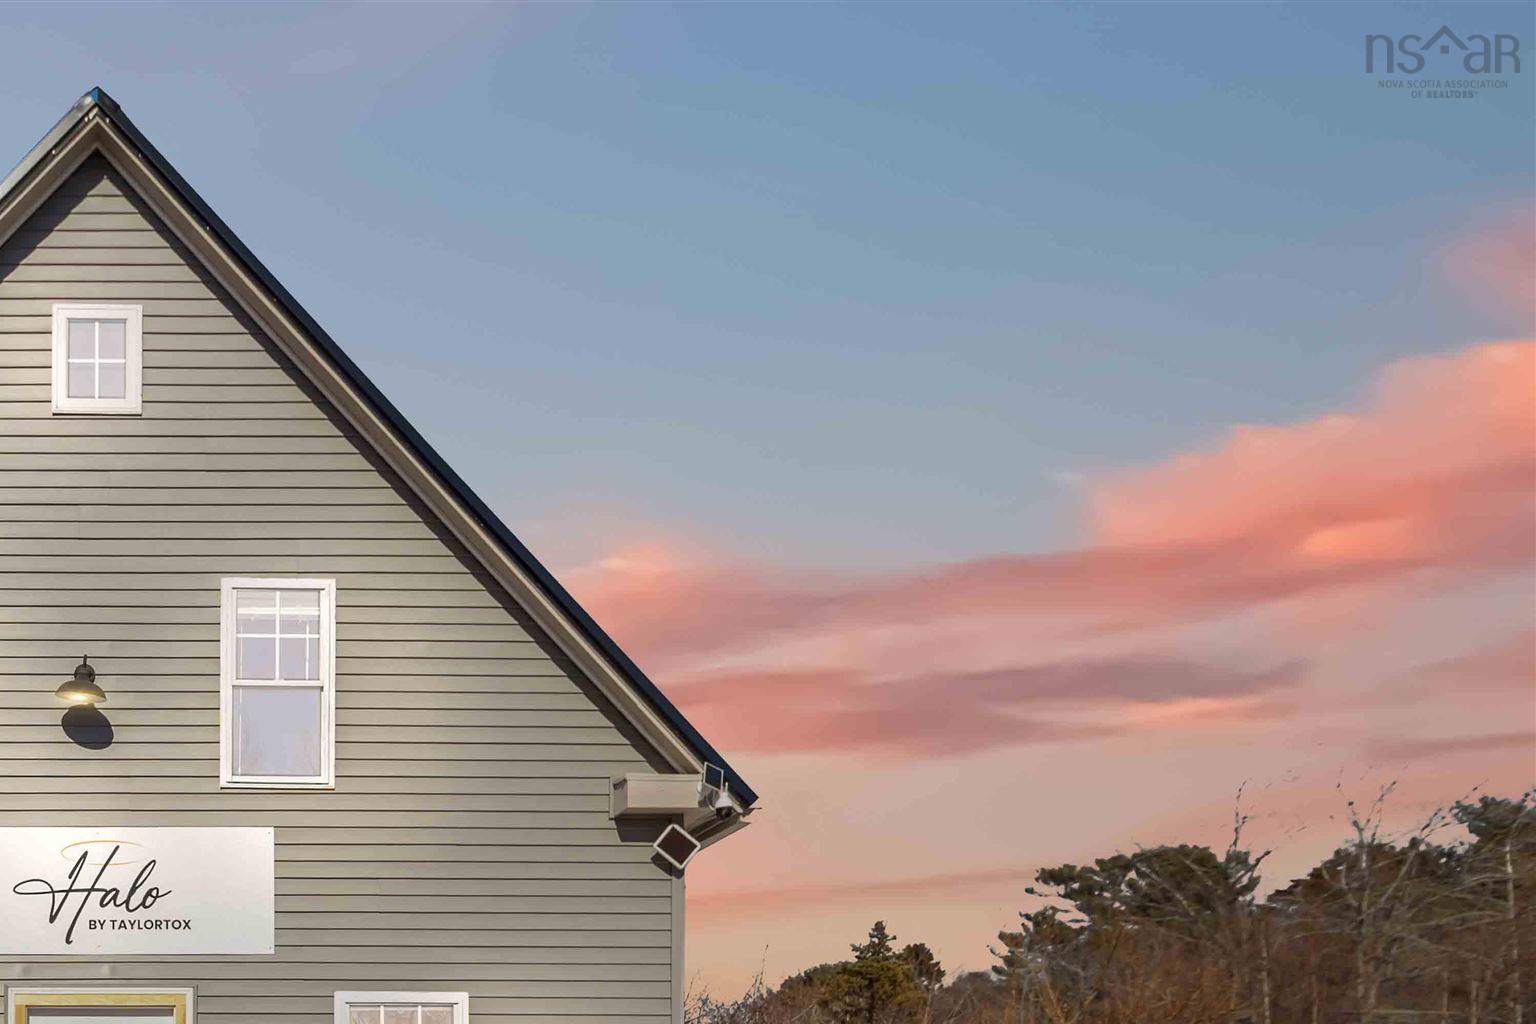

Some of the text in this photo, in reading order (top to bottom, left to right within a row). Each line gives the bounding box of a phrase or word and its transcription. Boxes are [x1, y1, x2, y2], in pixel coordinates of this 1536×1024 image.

[13, 845, 172, 945] Halo
[88, 919, 192, 931] BY TAYLORTOX
